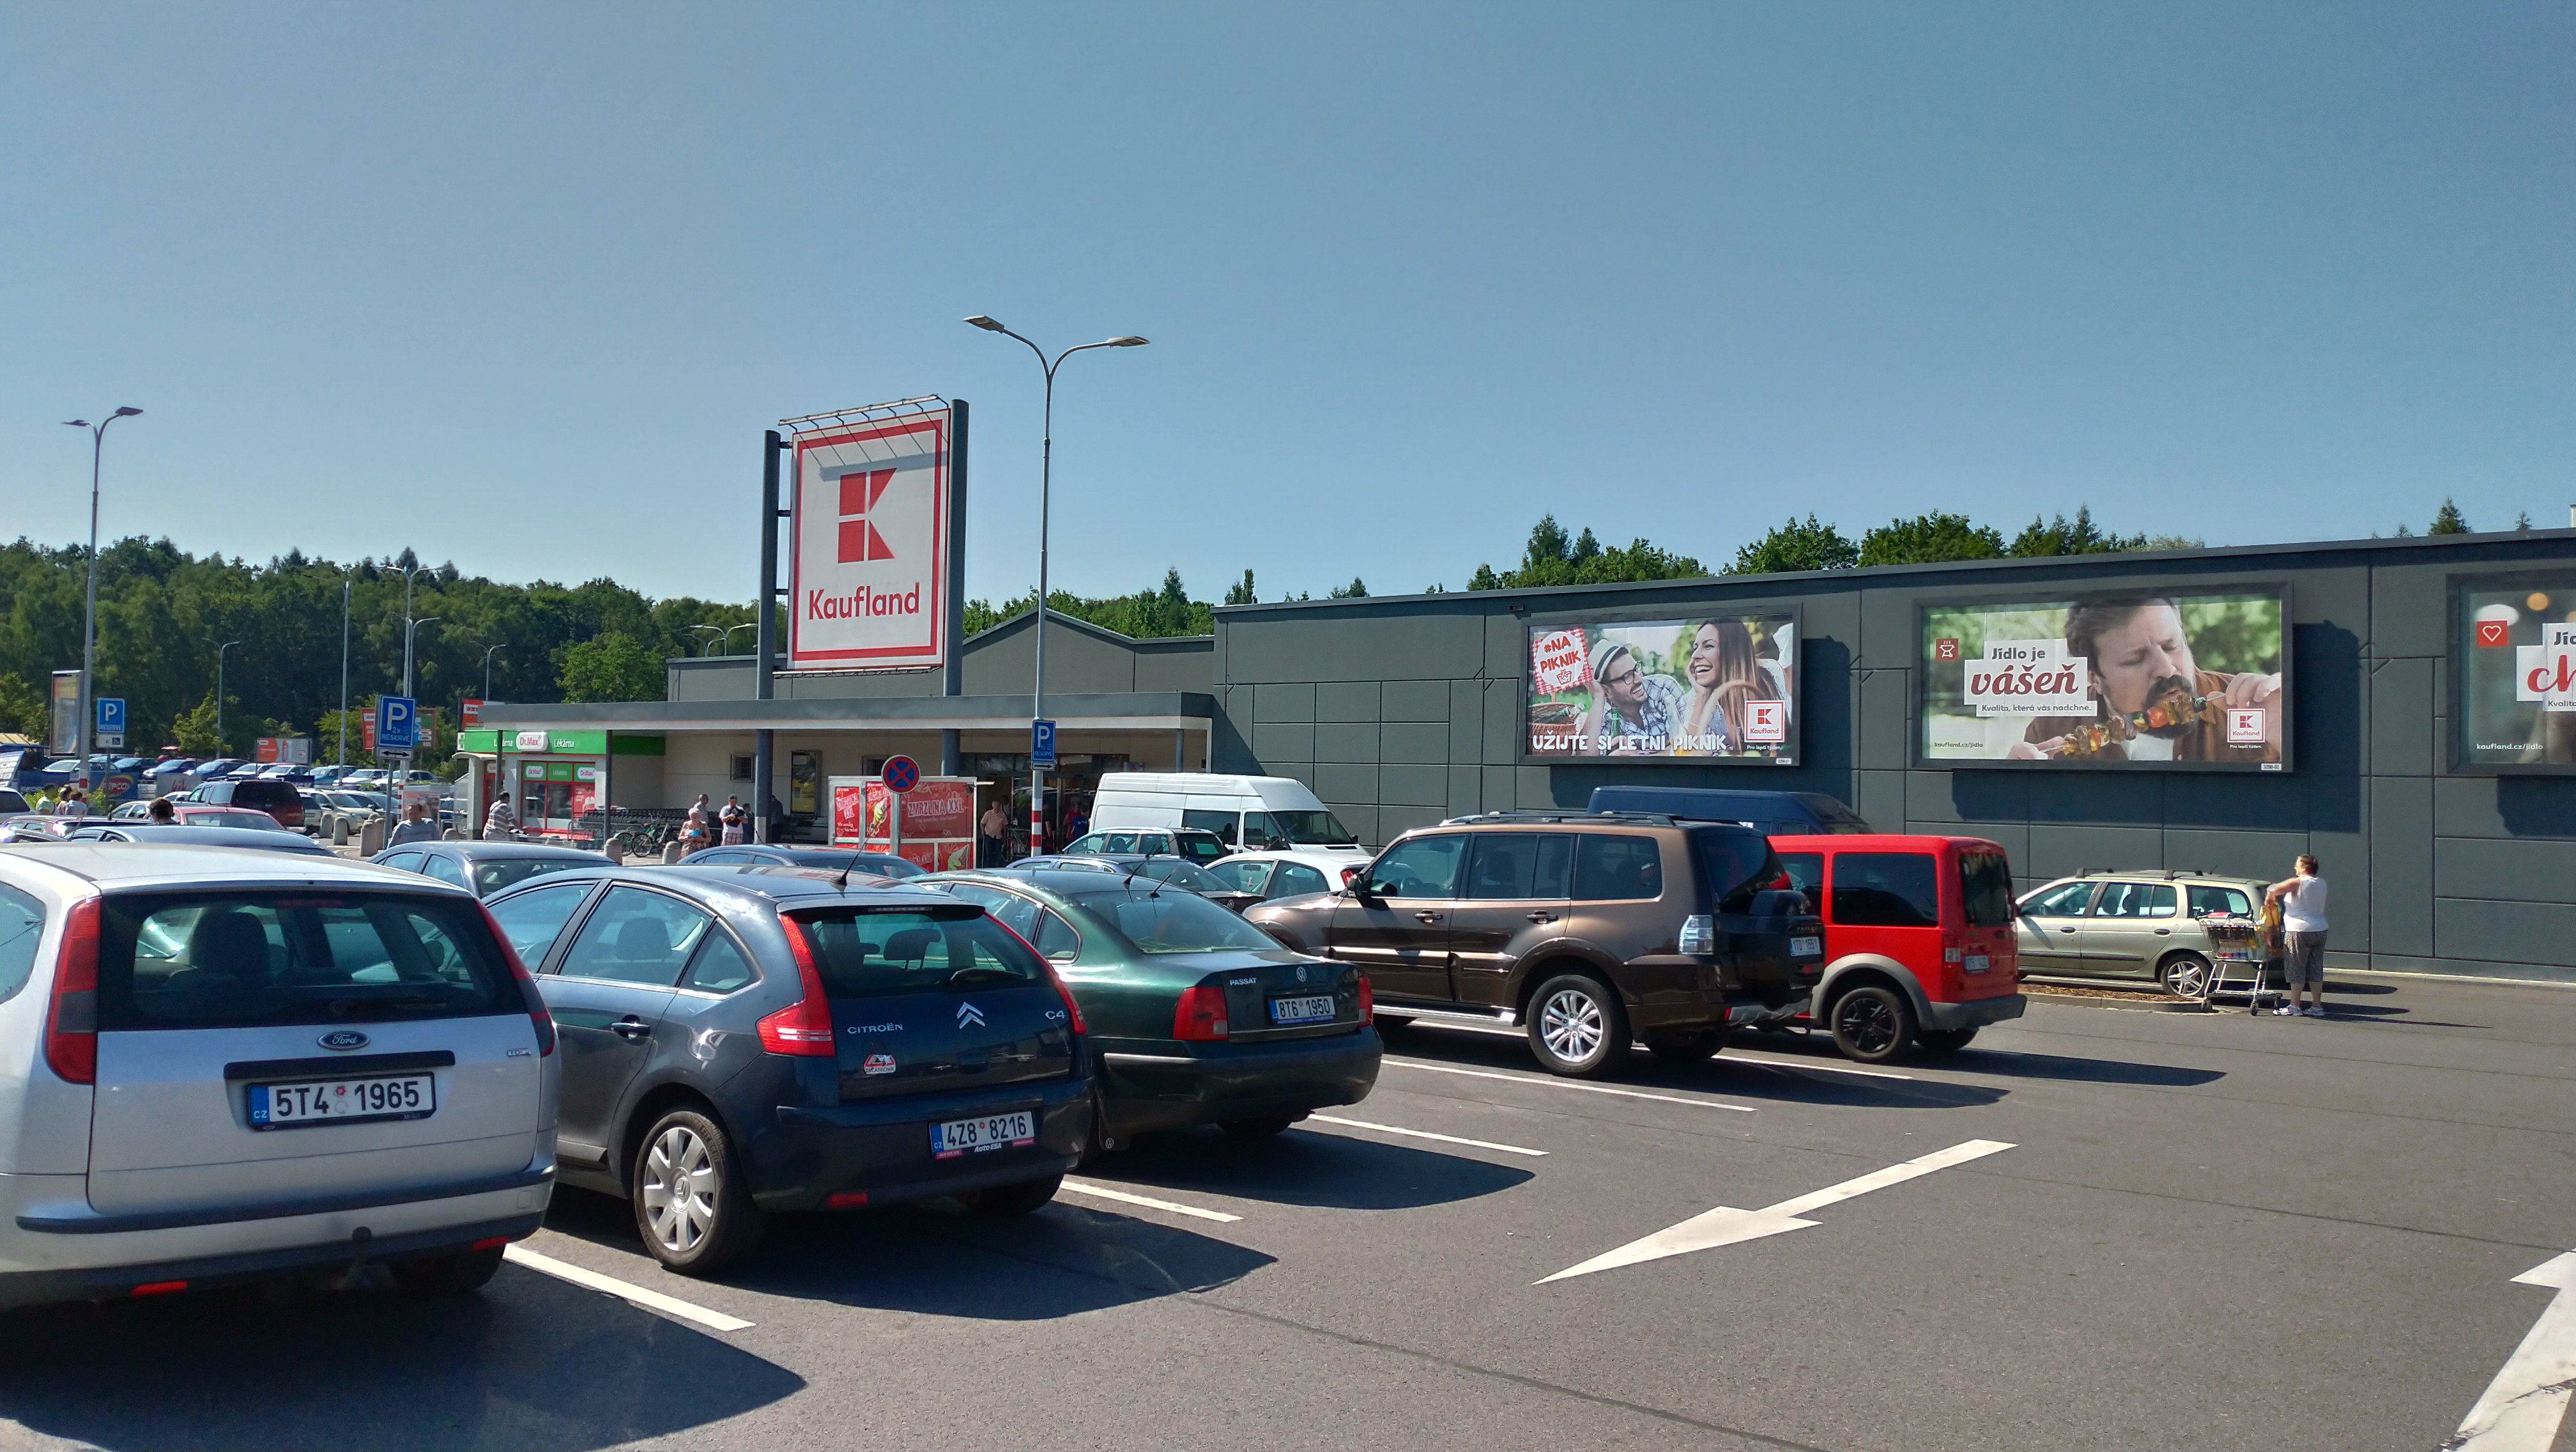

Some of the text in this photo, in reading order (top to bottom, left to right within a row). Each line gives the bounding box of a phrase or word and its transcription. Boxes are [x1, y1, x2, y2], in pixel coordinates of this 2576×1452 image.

[809, 582, 920, 620] Kaufland
[1544, 636, 1572, 653] #NA
[1540, 650, 1581, 674] PIKNIK
[1991, 647, 2046, 662] Jídlo je
[1970, 663, 2079, 695] vášeň
[105, 703, 118, 722] P
[386, 703, 408, 730] P
[1982, 704, 2011, 712] Kvalita,
[494, 738, 514, 747] Lárna
[554, 738, 574, 748] Lékárna
[1037, 725, 1050, 748] P
[1533, 729, 1588, 750] UŽIJTE
[1597, 735, 1612, 750] SI
[1673, 735, 1726, 750] PIKNIK
[2476, 743, 2543, 751] kaufland.cz/jidlo
[908, 798, 964, 817] ZMRZLINA XXL
[1229, 977, 1257, 986] PASSAT
[1045, 1010, 1066, 1020] C4
[1278, 998, 1331, 1018] 8T6 1950
[847, 1023, 903, 1034] CITROËN
[332, 1033, 358, 1045] Ford
[276, 1080, 419, 1116] 5T4 1965
[254, 1111, 267, 1119] CZ
[947, 1115, 1027, 1147] 4Z8 8216
